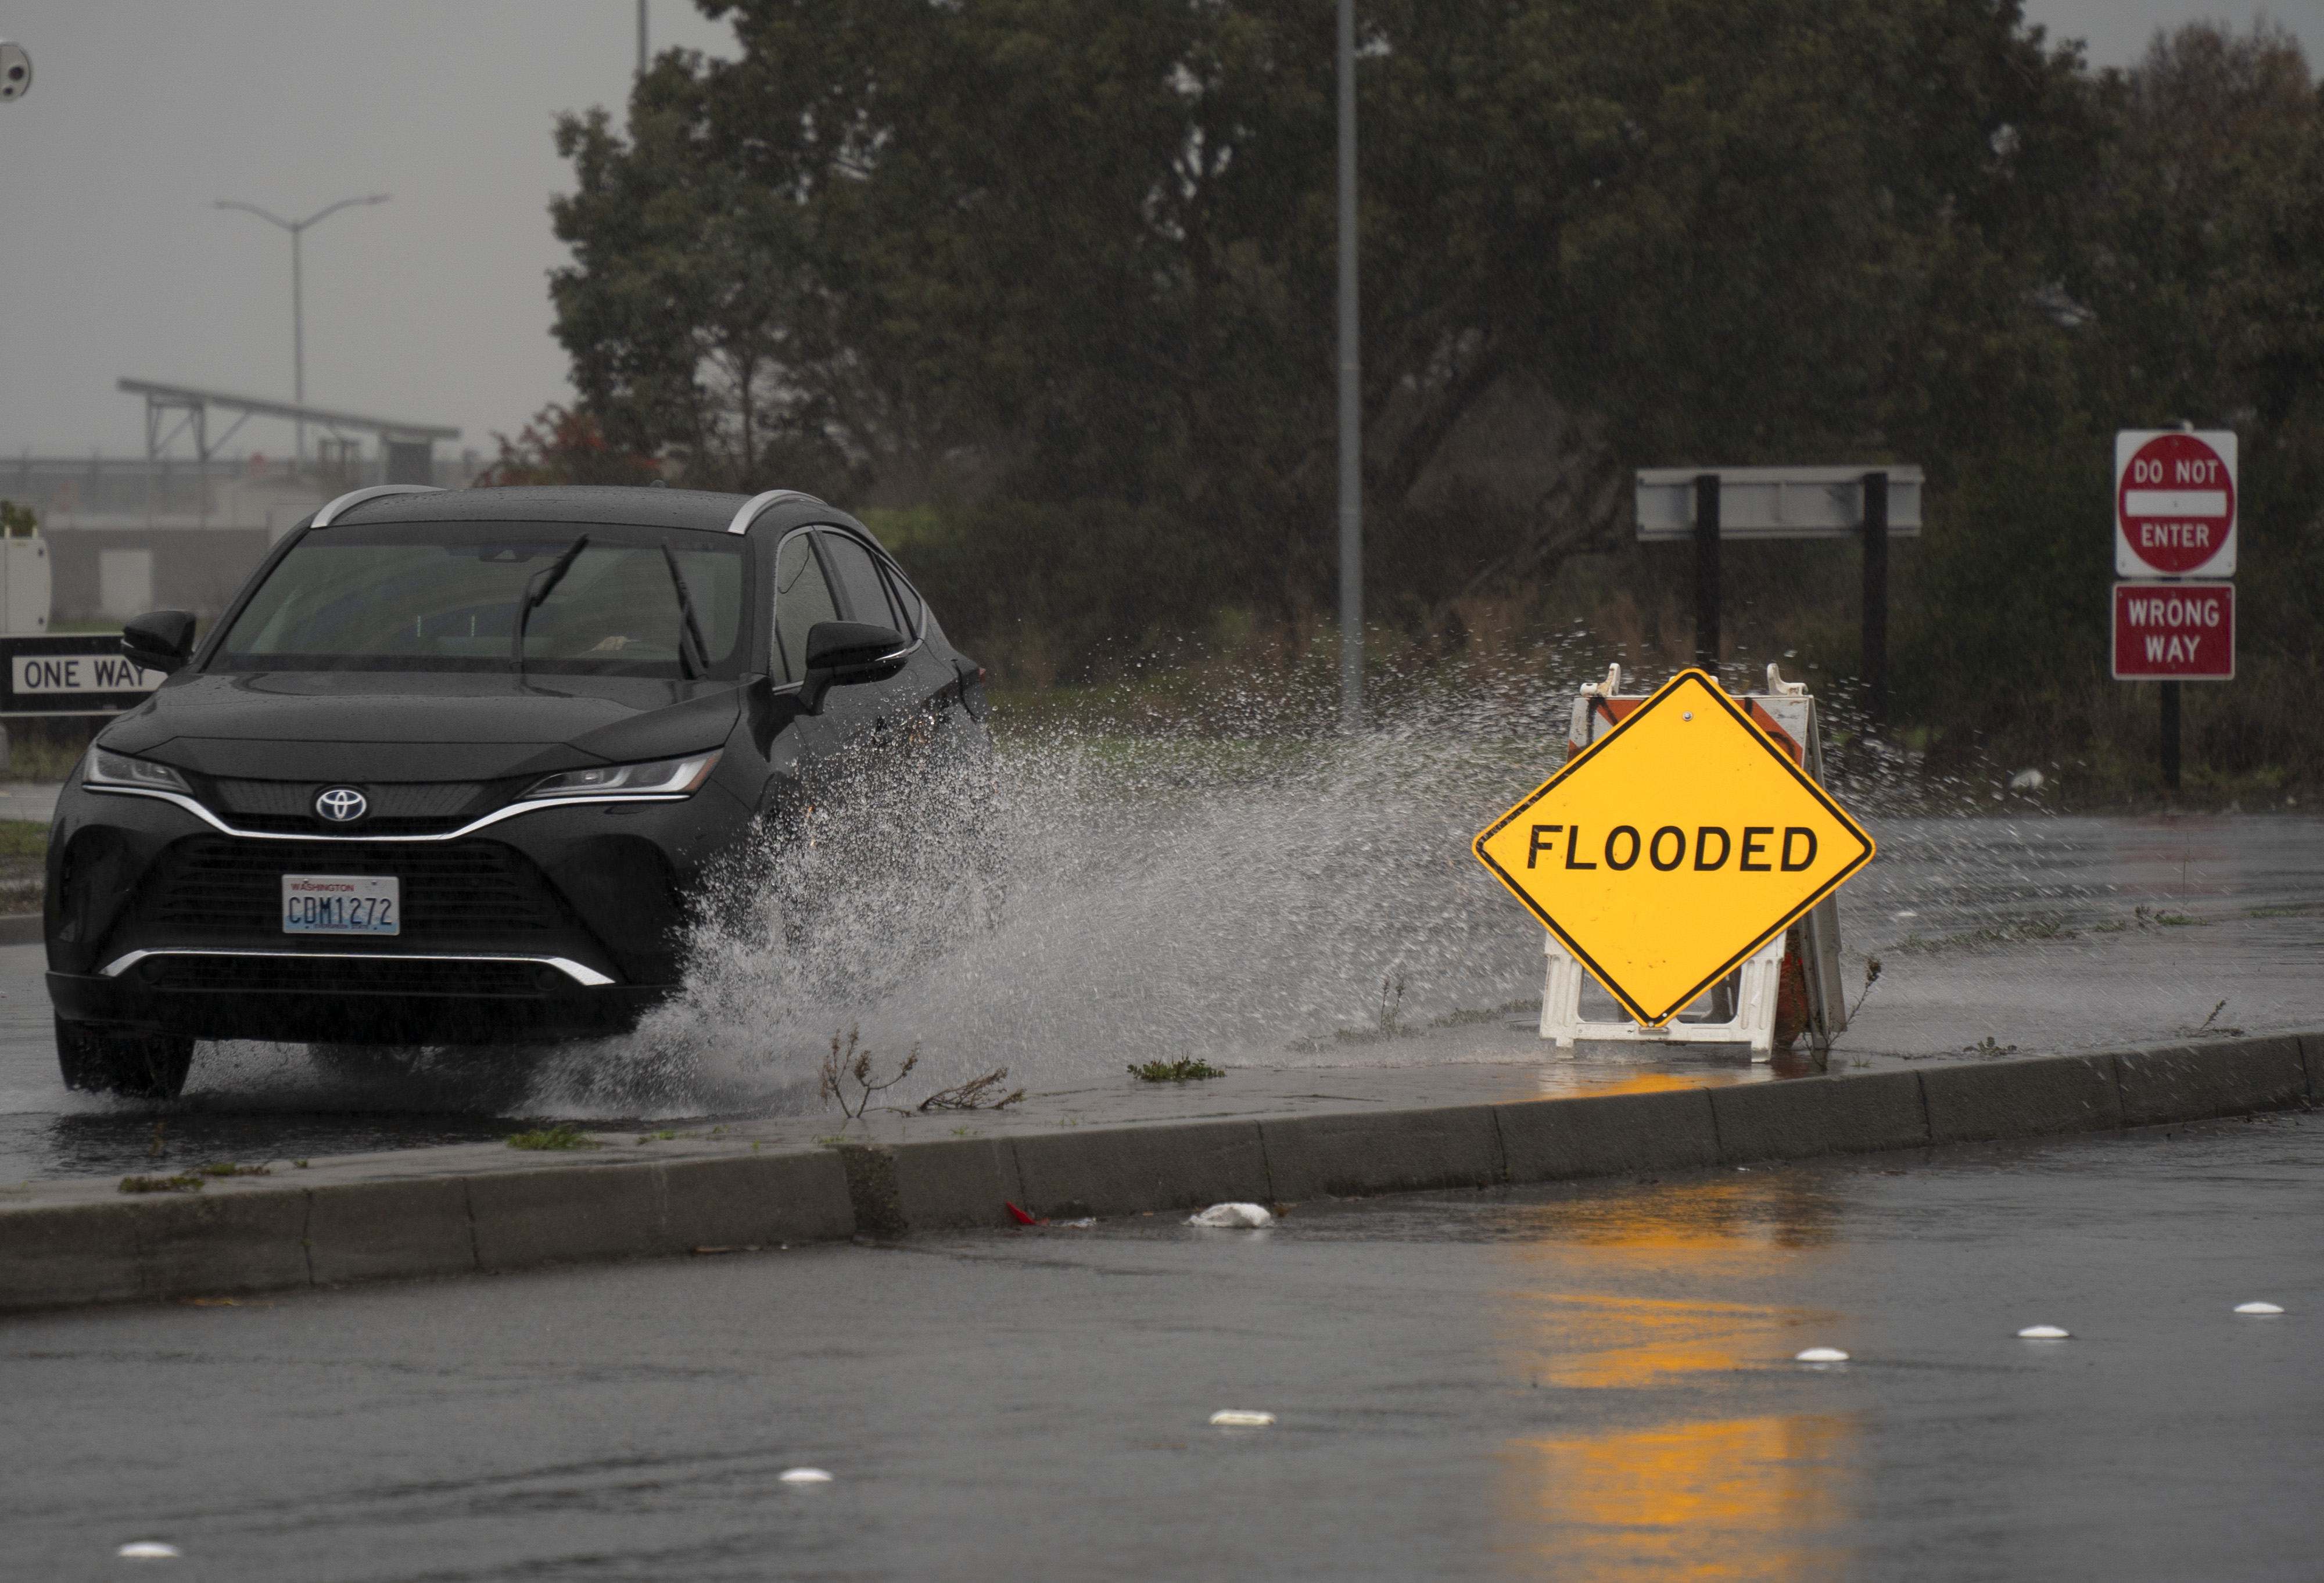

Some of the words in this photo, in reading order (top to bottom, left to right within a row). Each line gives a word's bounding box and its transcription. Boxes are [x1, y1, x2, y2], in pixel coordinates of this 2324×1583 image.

[2134, 458, 2163, 484] DO
[2175, 458, 2219, 484] NOT
[2141, 523, 2210, 548] ENTER
[2128, 598, 2220, 627] WRONG
[2145, 635, 2201, 663] WAY
[24, 660, 80, 689] ONE
[94, 659, 145, 687] WAY
[1527, 824, 1819, 872] FLOODED
[291, 882, 355, 892] WASHINGTON
[289, 896, 393, 925] CDM1272
